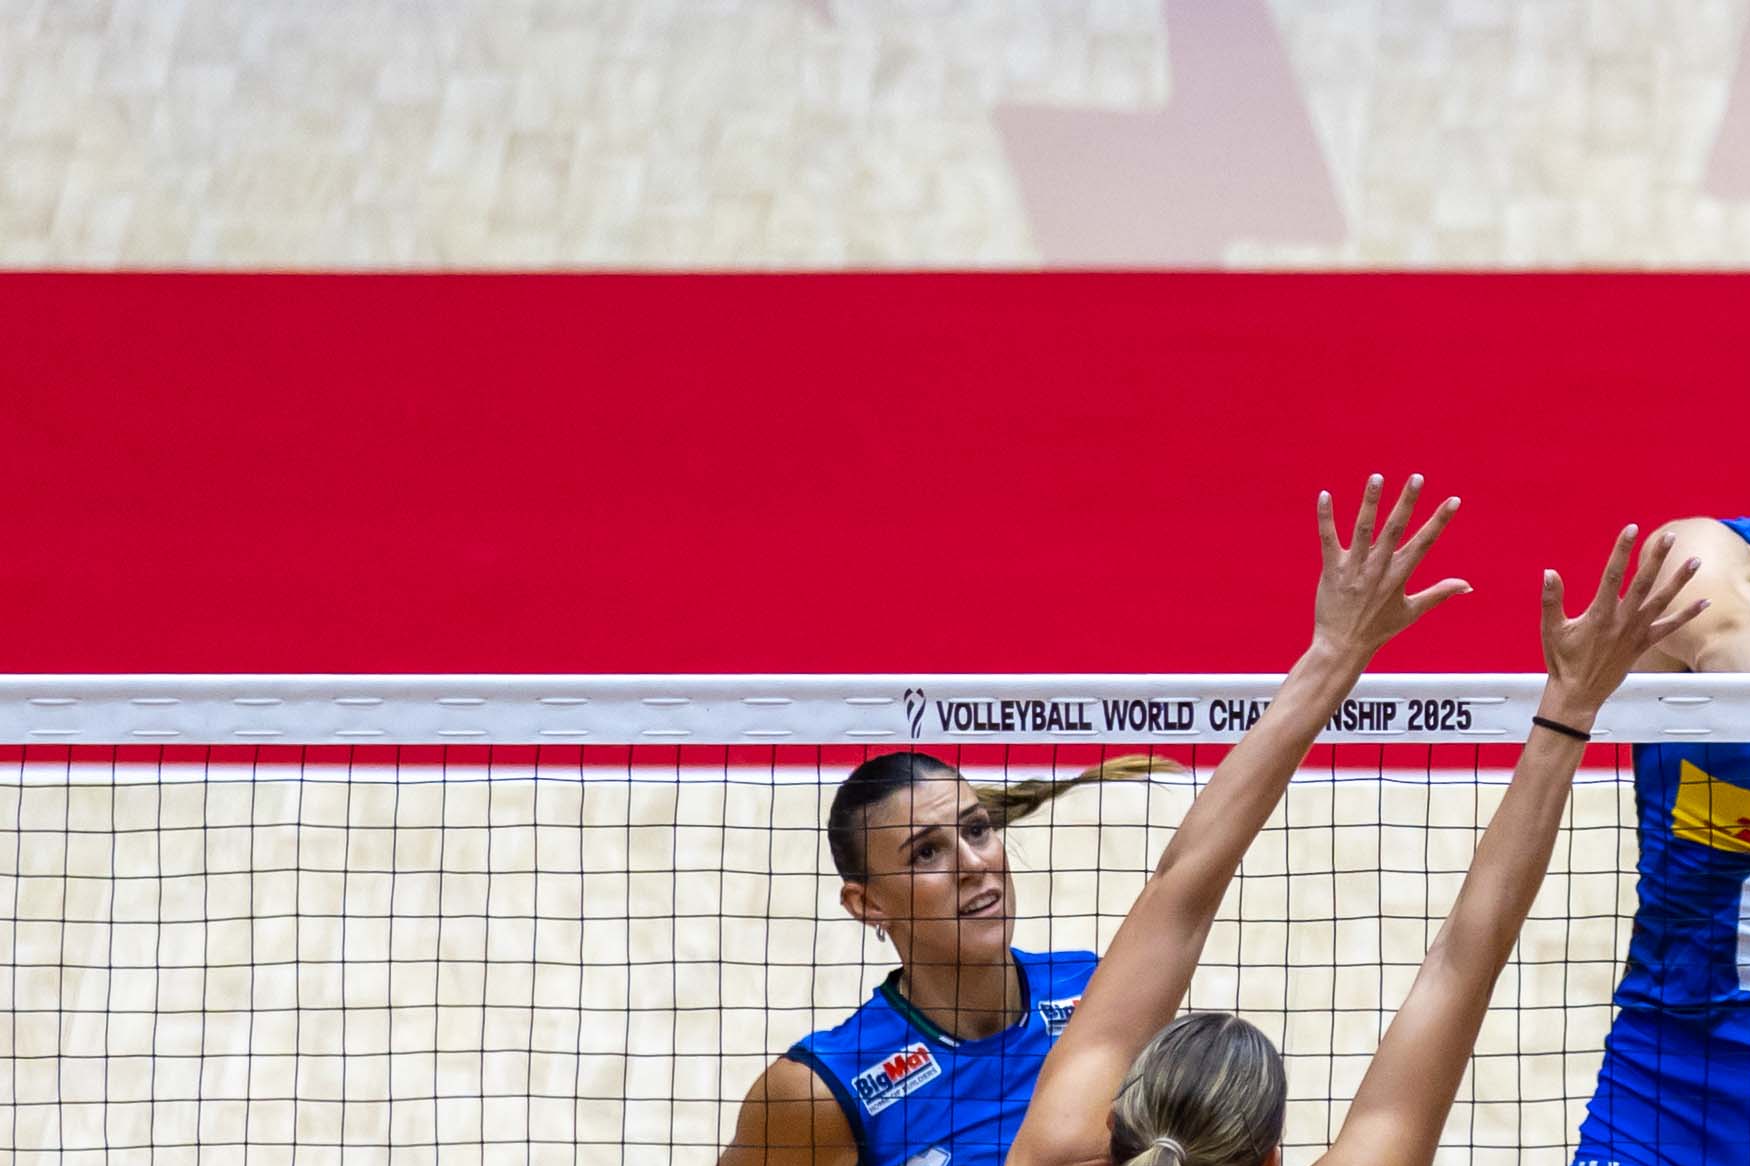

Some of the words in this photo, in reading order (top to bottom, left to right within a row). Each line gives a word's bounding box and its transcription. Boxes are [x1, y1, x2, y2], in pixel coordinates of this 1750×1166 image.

[936, 700, 1092, 731] VOLLEYBALL
[1103, 700, 1194, 731] WORLD
[1209, 700, 1397, 731] CHANSHIP
[1408, 700, 1472, 731] 2025
[855, 1047, 930, 1102] BigMat
